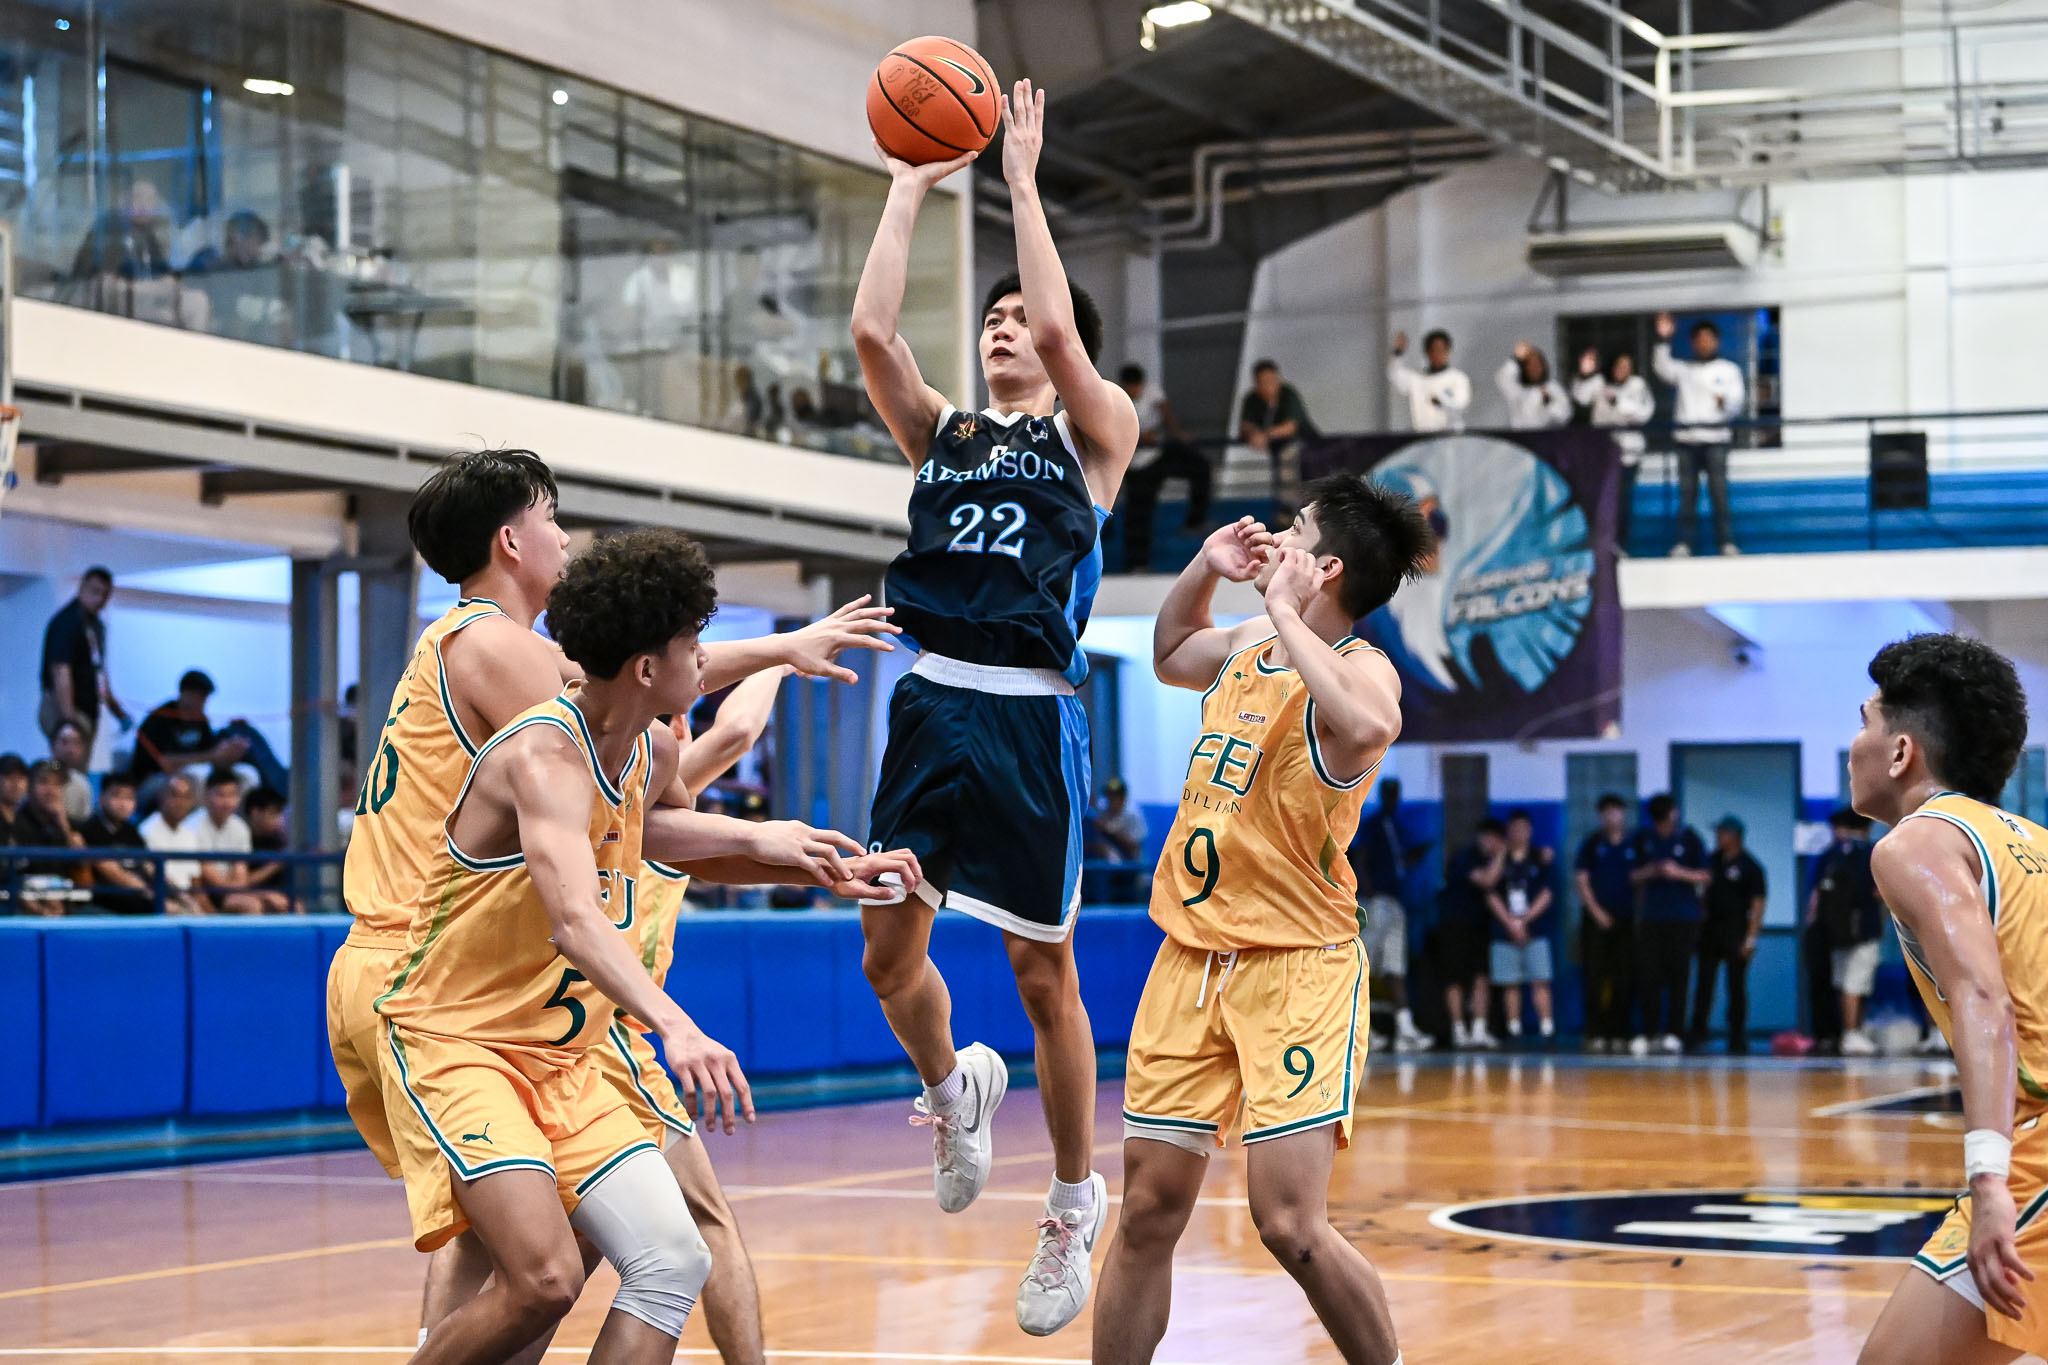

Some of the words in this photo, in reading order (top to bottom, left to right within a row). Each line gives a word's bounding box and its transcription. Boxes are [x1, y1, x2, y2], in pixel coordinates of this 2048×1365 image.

[947, 501, 1027, 559] 22
[1182, 788, 1242, 814] DILIN
[1182, 827, 1220, 907] 9
[542, 968, 587, 1046] 5
[1283, 1045, 1315, 1099] 9
